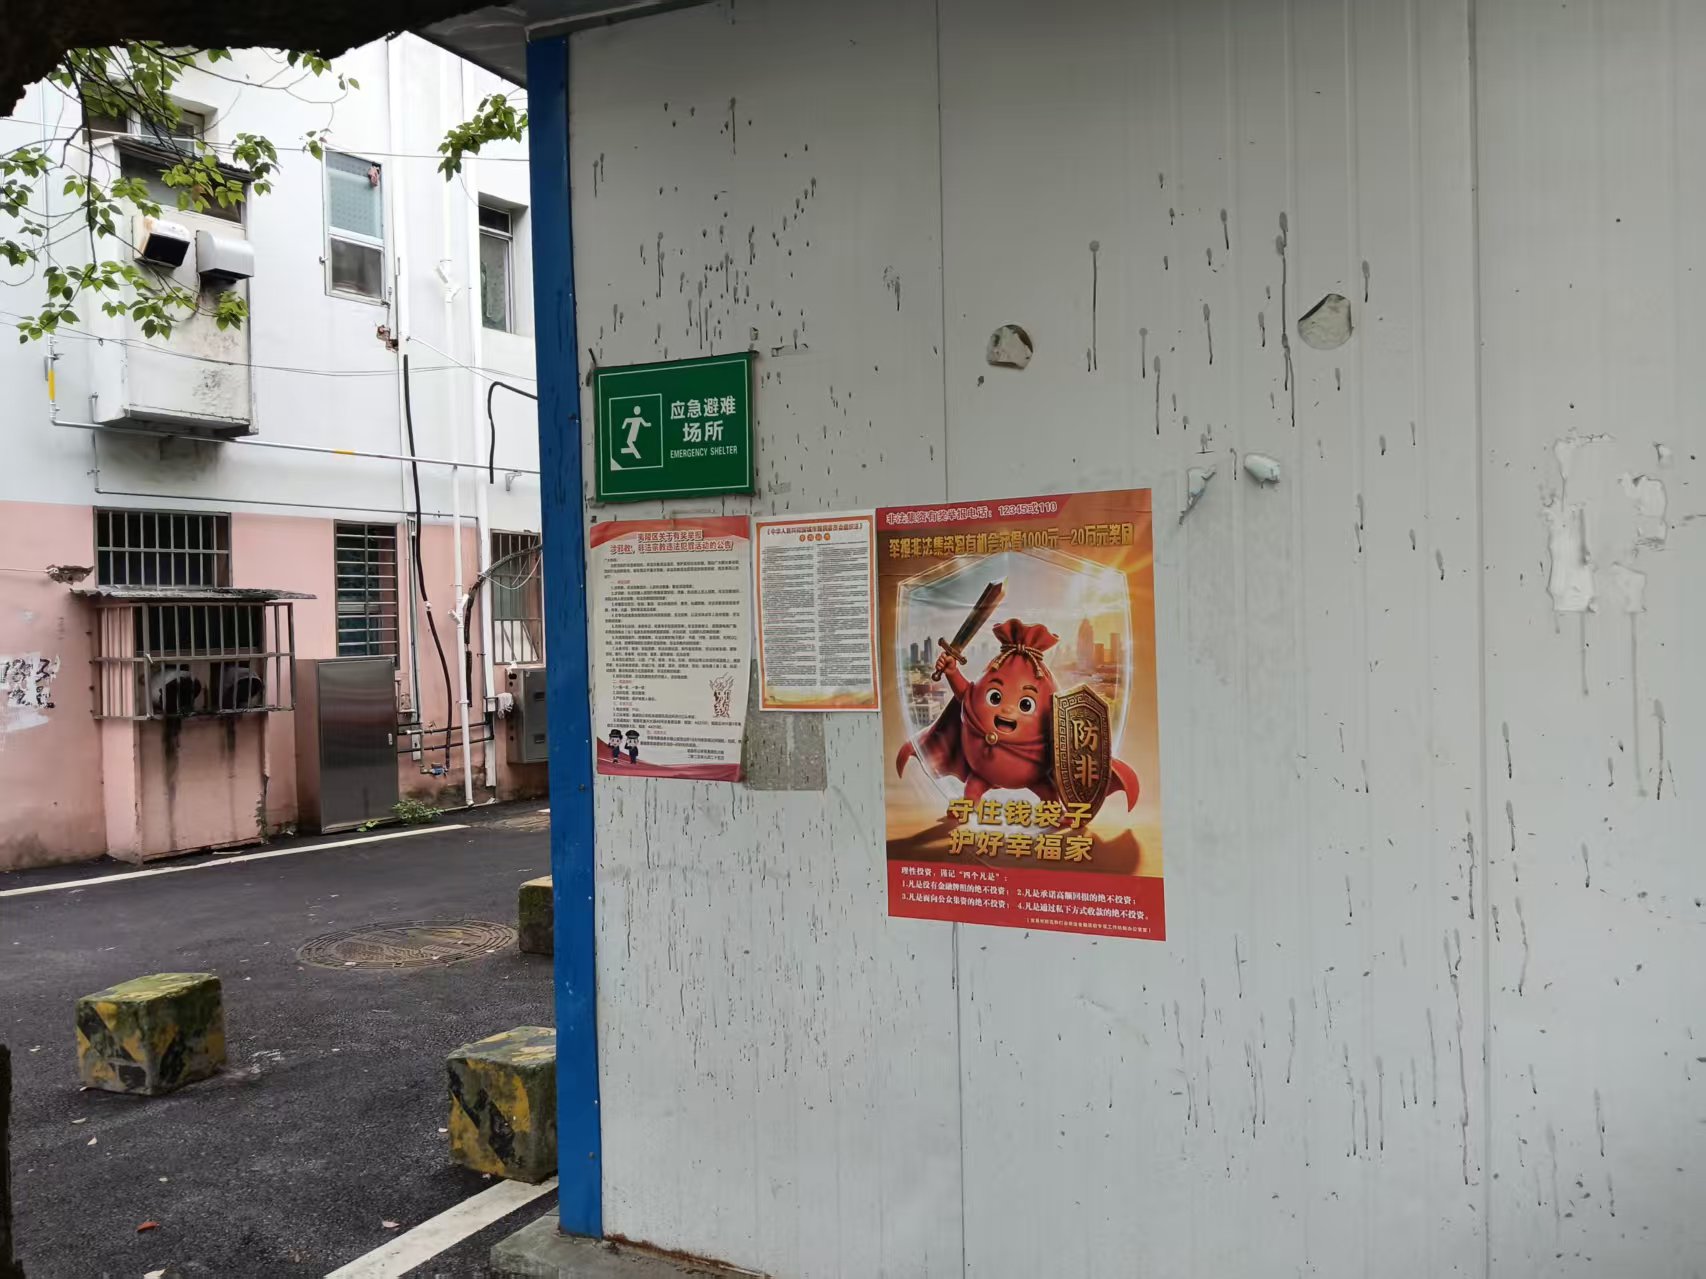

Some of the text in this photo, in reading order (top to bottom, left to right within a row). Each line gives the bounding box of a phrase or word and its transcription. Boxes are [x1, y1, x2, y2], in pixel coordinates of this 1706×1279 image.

[671, 395, 736, 419] 应急避难
[683, 420, 724, 442] 场所
[670, 445, 738, 459] EMERGENCY SHELTER
[1072, 719, 1099, 788] 防非
[947, 798, 1093, 829] 守住钱袋子
[948, 828, 1093, 862] 护好幸福家
